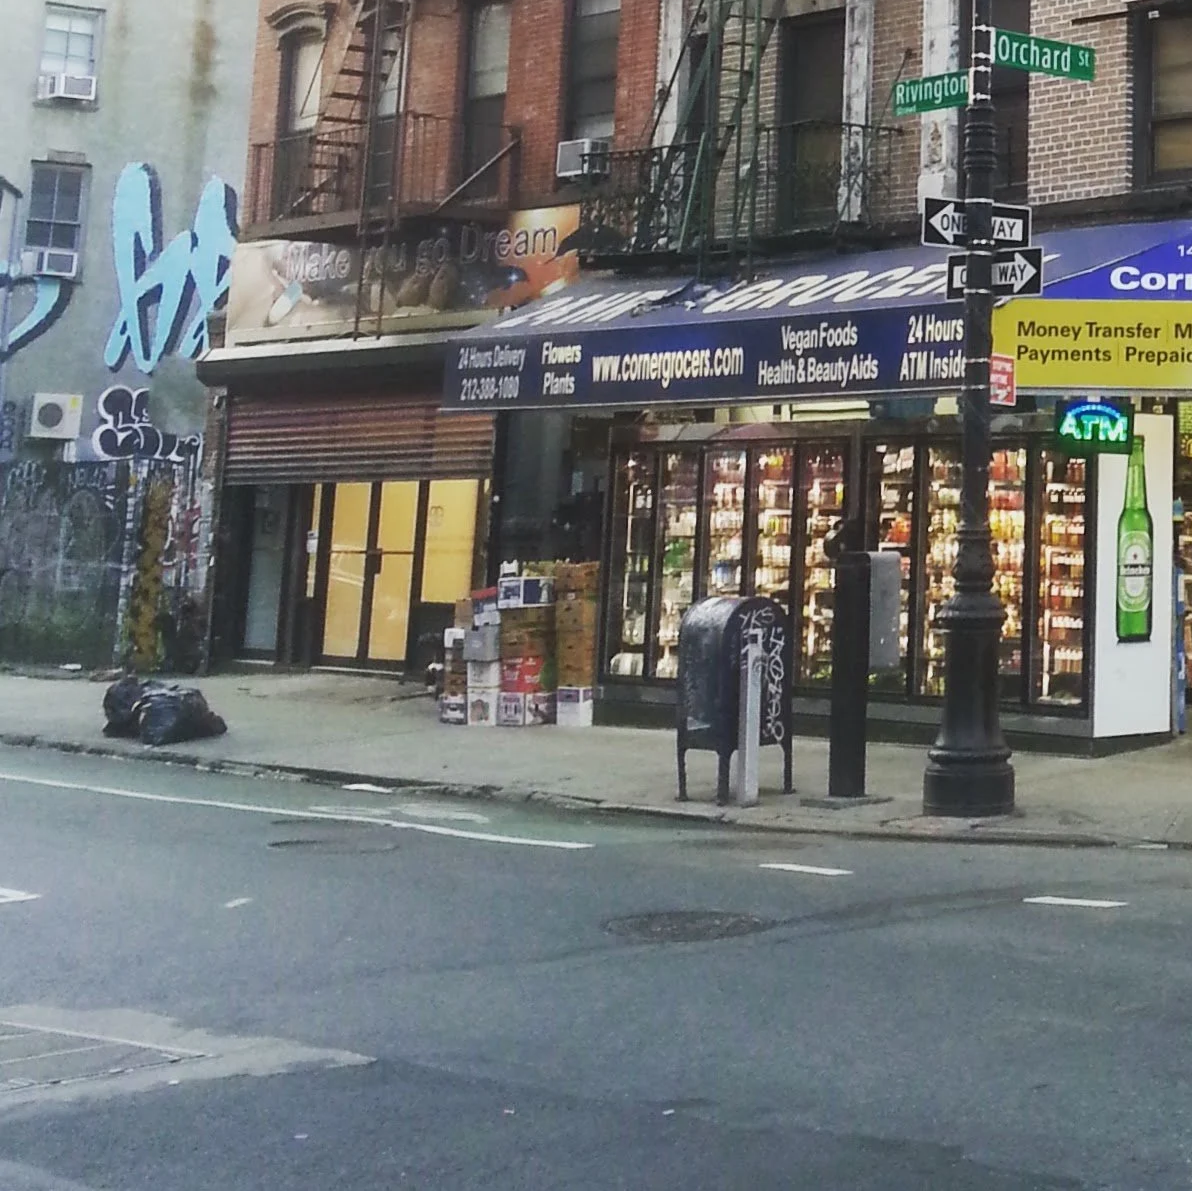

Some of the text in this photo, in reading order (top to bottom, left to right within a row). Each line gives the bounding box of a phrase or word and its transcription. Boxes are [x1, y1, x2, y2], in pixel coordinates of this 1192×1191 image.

[998, 35, 1090, 73] Orchard St
[896, 74, 969, 105] Rivington
[991, 219, 1017, 238] AY
[285, 241, 351, 283] Make
[460, 222, 558, 264] Dream
[998, 263, 1027, 282] WAY
[781, 320, 858, 356] Vegan Foods
[907, 313, 964, 344] 24 Hours
[1017, 321, 1161, 341] Money Transfer
[469, 347, 493, 368] Hours
[493, 344, 526, 371] Delivery
[542, 341, 582, 365] Flowers
[592, 346, 744, 389] www.cornergrocers.com
[900, 351, 927, 382] ATM
[1017, 345, 1112, 365] Payments
[543, 372, 576, 395] Plants
[758, 353, 879, 388] Health & Beauty Aids
[1060, 414, 1128, 442] ATM
